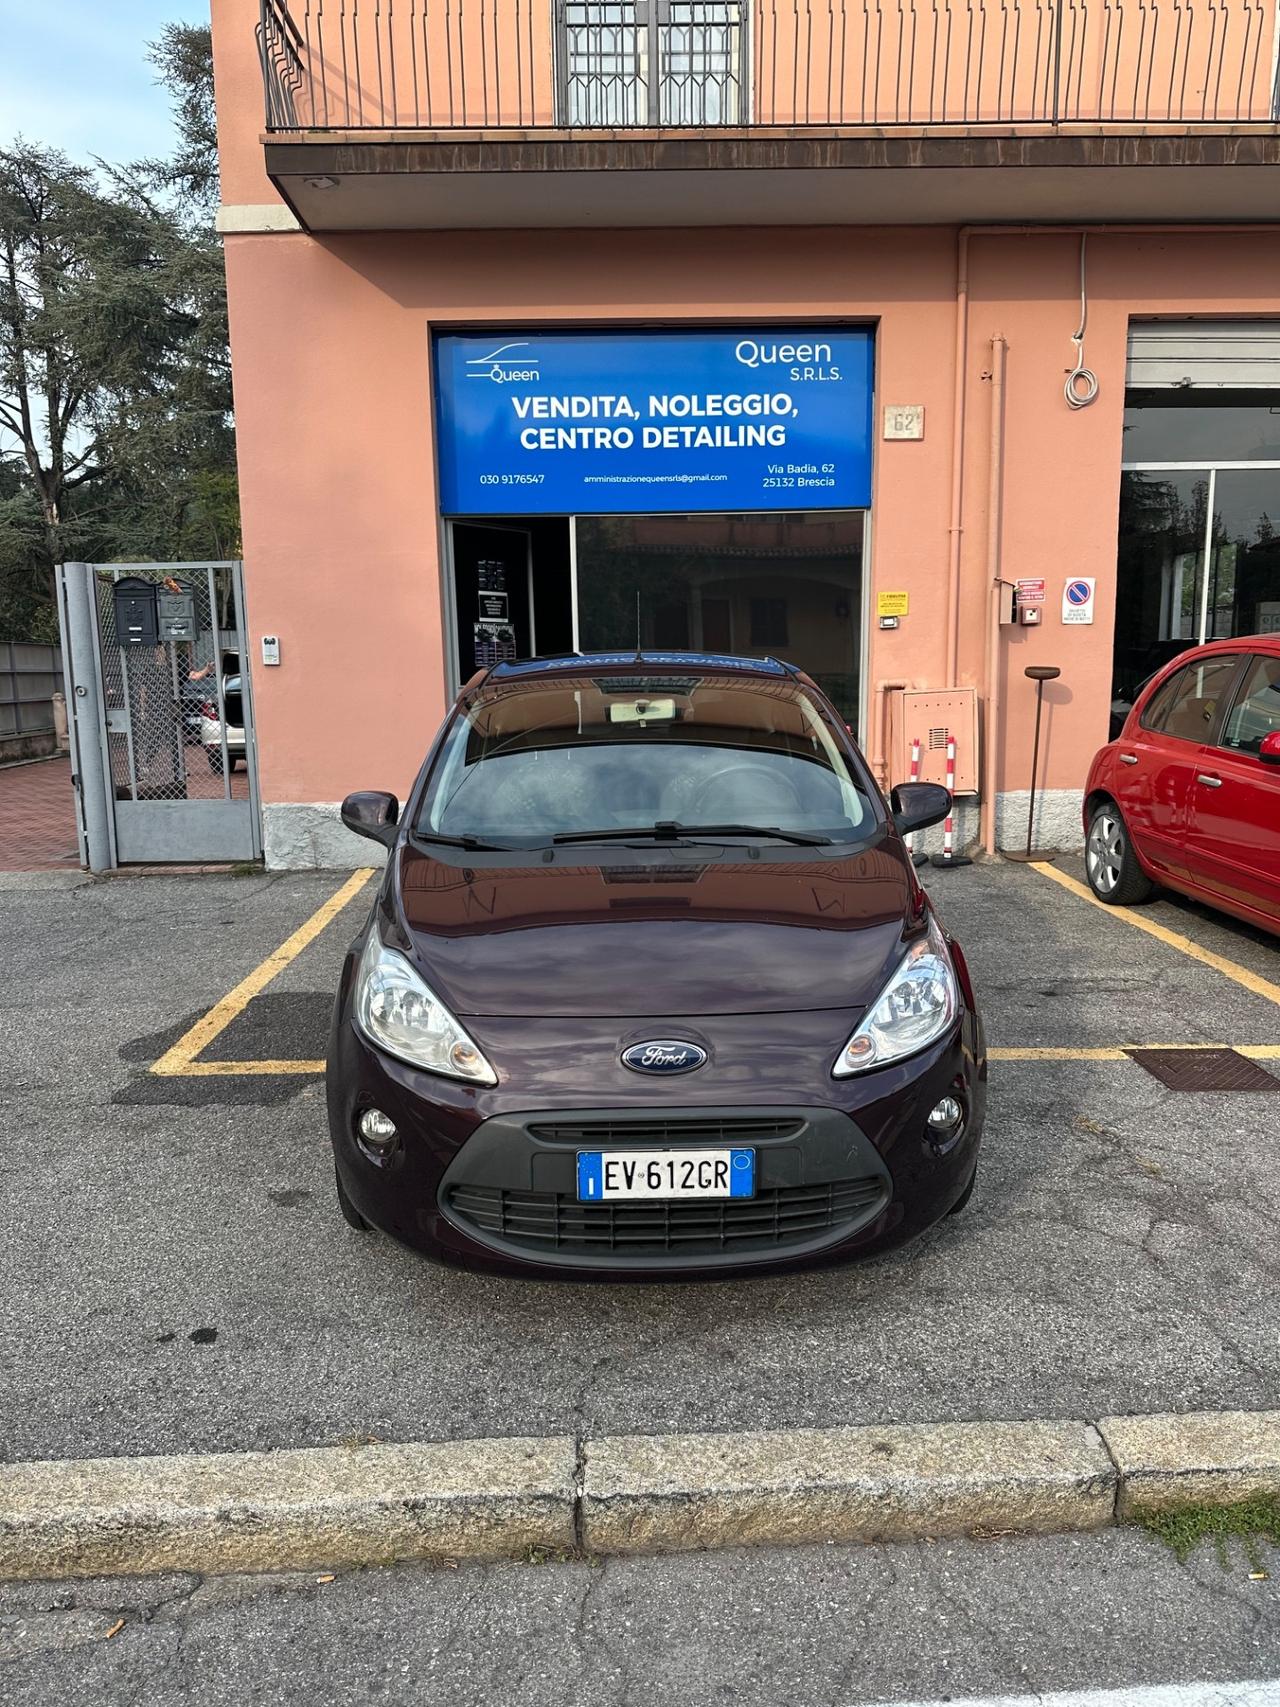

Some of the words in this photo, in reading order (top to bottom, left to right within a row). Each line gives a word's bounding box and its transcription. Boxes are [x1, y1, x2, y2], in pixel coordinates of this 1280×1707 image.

[735, 340, 832, 368] Queen
[490, 367, 540, 383] Queen
[789, 366, 844, 382] S.R.L.S.
[511, 395, 641, 421] VENDITA,
[648, 393, 799, 418] NOLEGGIO,
[520, 426, 634, 450] CENTRO
[642, 424, 786, 449] DETAILING
[767, 464, 784, 474] Via
[787, 463, 819, 475] Badia,
[821, 463, 835, 473] 62
[479, 474, 500, 485] 030
[501, 474, 545, 484] 9176547
[584, 474, 728, 484] amministrazionequeensrls@gmail.com
[762, 477, 795, 488] 25132
[797, 476, 835, 488] Brescia
[641, 1045, 687, 1066] Ford
